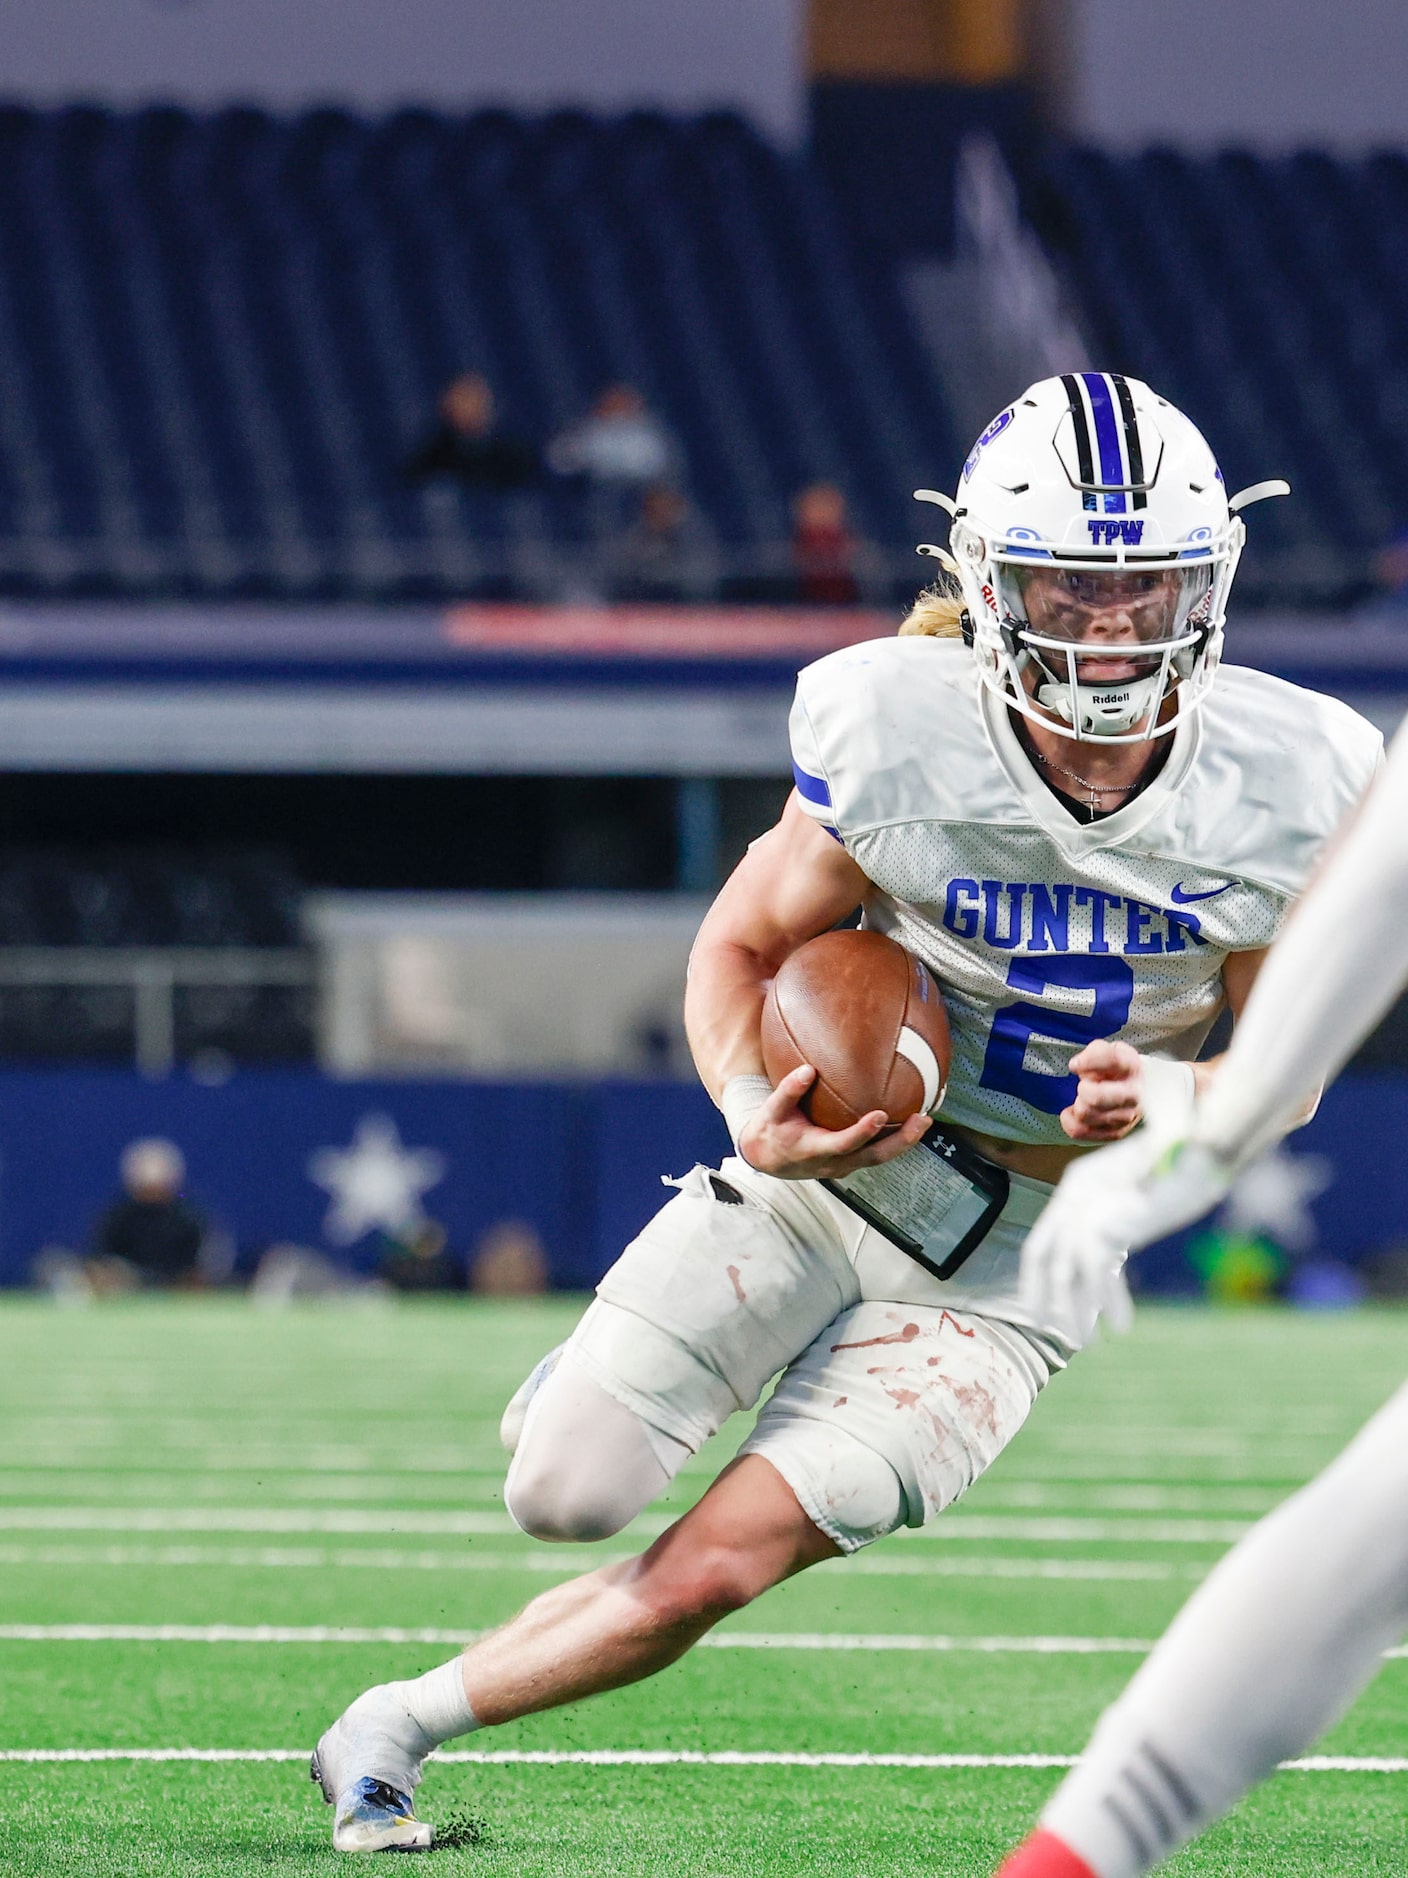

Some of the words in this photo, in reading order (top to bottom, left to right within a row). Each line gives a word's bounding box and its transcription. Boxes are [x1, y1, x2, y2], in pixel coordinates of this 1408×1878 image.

[1088, 520, 1144, 545] TPW
[1092, 692, 1130, 704] Riddell
[942, 878, 1209, 954] GUNTER
[979, 953, 1134, 1116] 2
